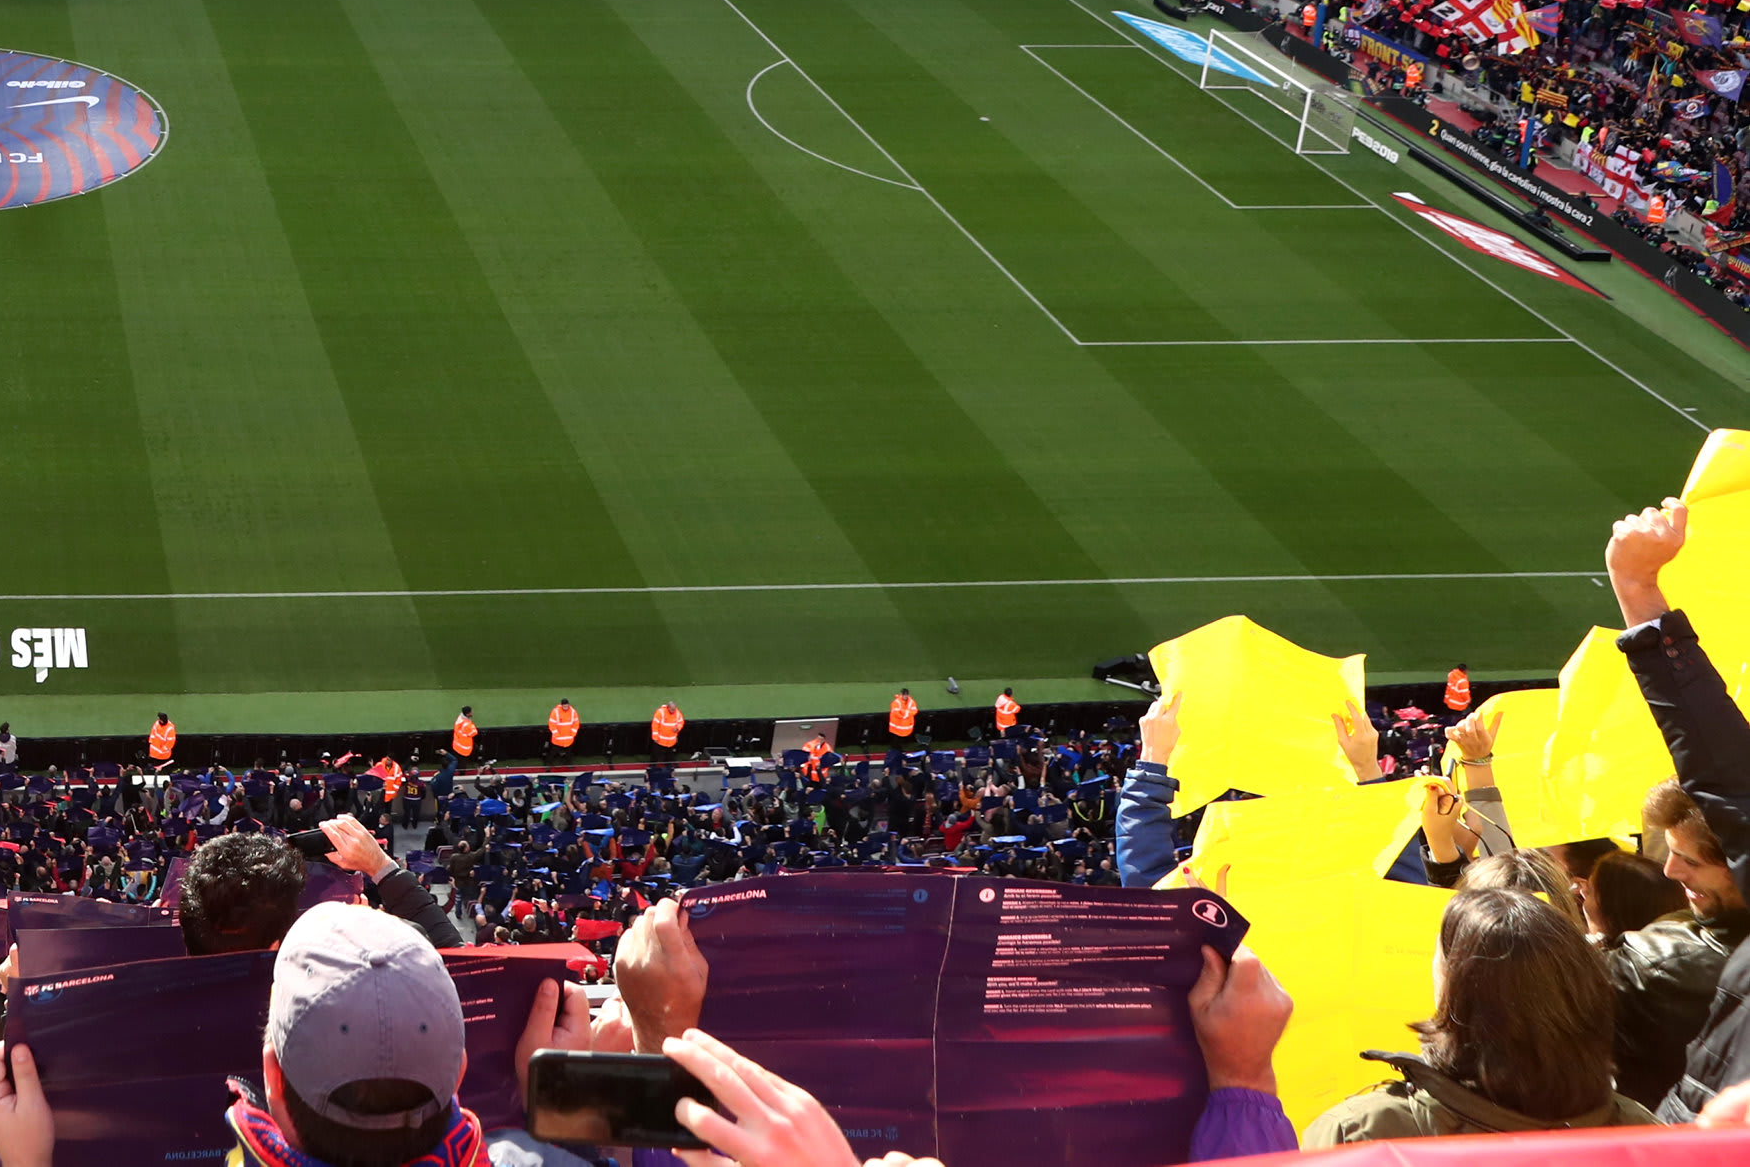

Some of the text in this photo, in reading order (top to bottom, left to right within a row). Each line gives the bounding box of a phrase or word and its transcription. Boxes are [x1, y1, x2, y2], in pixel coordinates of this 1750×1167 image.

[1428, 119, 1440, 136] 2
[1351, 126, 1399, 164] PES2019
[9, 153, 43, 163] FC
[1586, 216, 1593, 226] 2
[10, 628, 88, 683] MÉS
[1202, 902, 1218, 922] 1
